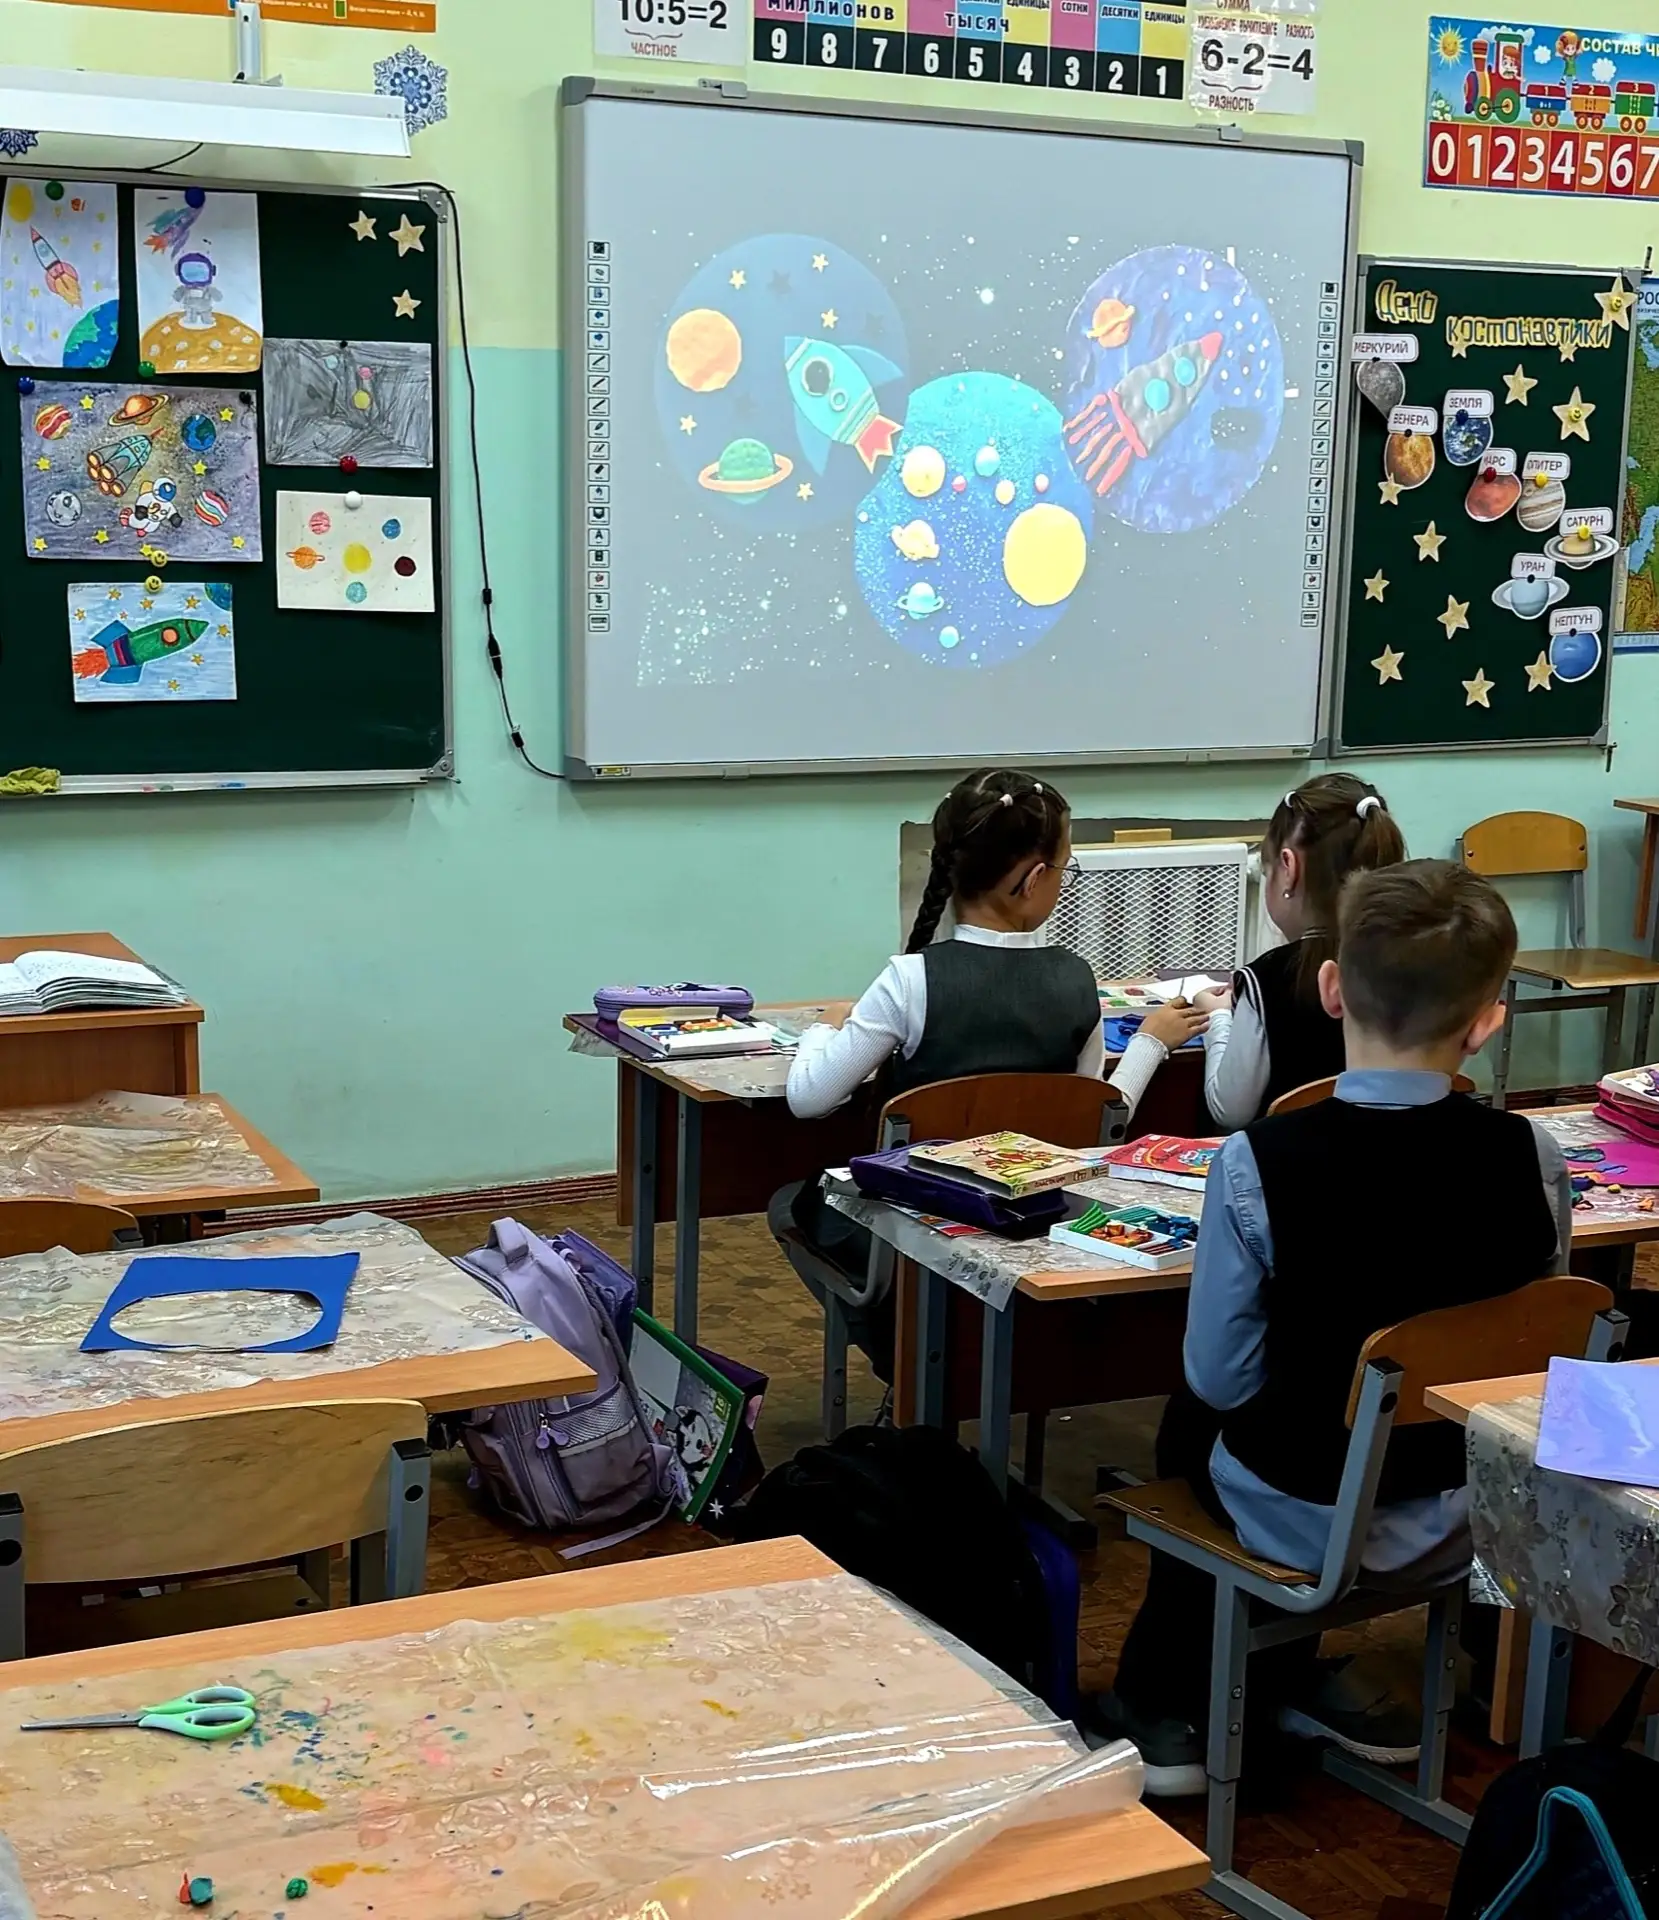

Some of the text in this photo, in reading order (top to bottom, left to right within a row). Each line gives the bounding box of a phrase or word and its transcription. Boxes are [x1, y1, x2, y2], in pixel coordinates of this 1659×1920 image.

[767, 0, 895, 20] МИЛЛИОНОВ
[1061, 2, 1088, 13] СОТНИ
[1102, 6, 1139, 18] ДЕСЯТКИ
[945, 13, 1009, 32] ТЫСЯЧ
[1144, 11, 1185, 24] ЕДИНИЦЫ
[631, 42, 678, 57] ЧАСТНОЕ
[1582, 37, 1642, 55] СОСТАВ
[771, 28, 1167, 95] 9 8 7 6 5 4 3 2 1
[1201, 38, 1314, 80] 6-2=4
[1588, 85, 1595, 95] 2
[1633, 83, 1640, 93] 3
[1208, 94, 1255, 111] РАЗНОСТЬ
[1431, 132, 1659, 190] 0 1 2 3 4 5 6 7
[1354, 341, 1409, 354] МЕРКУРИЙ
[1449, 397, 1482, 409] ЗЕМЛЯ
[1393, 412, 1430, 426] ВЕНЕРА
[1567, 515, 1604, 528] САТУРН
[1521, 560, 1546, 572] УРАН
[1555, 613, 1593, 628] НЕПТУН
